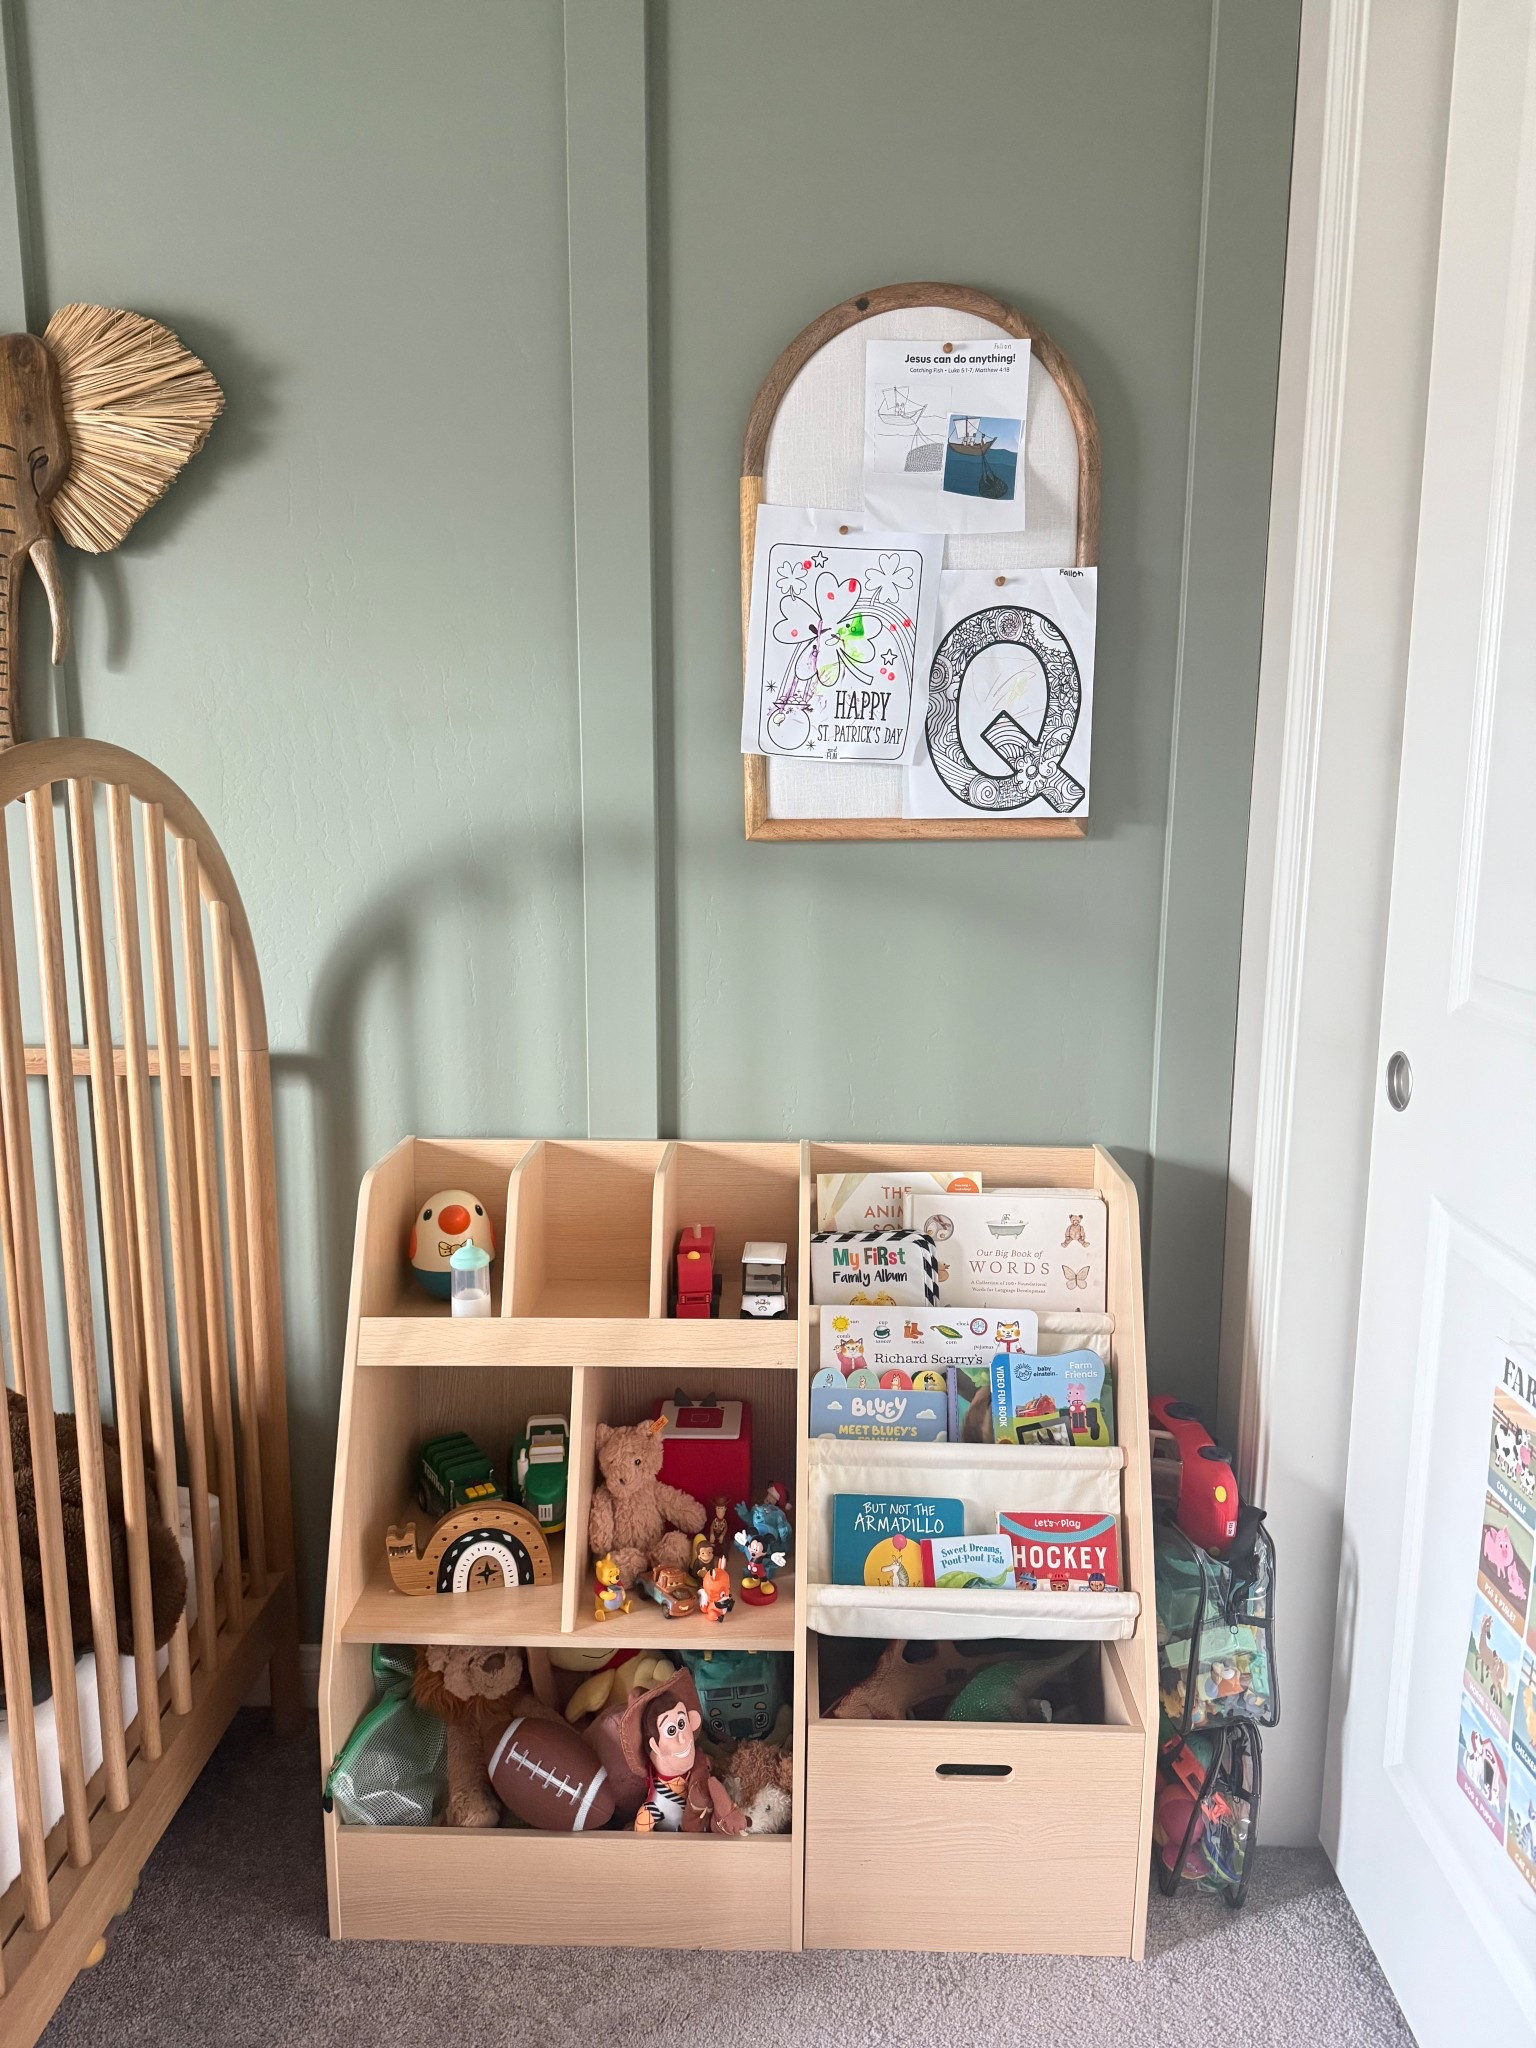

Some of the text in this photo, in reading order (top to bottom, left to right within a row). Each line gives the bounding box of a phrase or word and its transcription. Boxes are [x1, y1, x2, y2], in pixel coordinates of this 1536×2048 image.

[904, 353, 1016, 366] Jesus can do anything!
[909, 366, 933, 375] Catching
[933, 366, 944, 374] Fish
[948, 366, 960, 374] Luke
[975, 365, 998, 374] Matthew
[1059, 568, 1084, 578] Fallon
[833, 690, 892, 721] HAPPY
[925, 605, 1086, 813] Q
[817, 724, 904, 745] ST. PATRICK'S DAY
[832, 1247, 860, 1271] My
[976, 1249, 1044, 1260] Our Big Book of
[969, 1260, 1050, 1275] WORDS
[832, 1268, 908, 1287] Family Album
[875, 1353, 983, 1366] Richard Scarry's
[1069, 1361, 1093, 1370] Farm
[1065, 1370, 1098, 1379] Friends
[996, 1366, 1008, 1427] VIDEO FUN BOOK
[851, 1396, 908, 1424] BLUEY
[838, 1424, 918, 1437] MEET BLUEY'S
[1496, 1480, 1509, 1497] COW
[1513, 1497, 1527, 1515] CALF
[862, 1501, 936, 1516] BUT NOT THE
[854, 1512, 944, 1534] ARMADILLO
[1034, 1518, 1081, 1530] Let's Play
[940, 1543, 1002, 1558] Sweet Dreams,
[1012, 1545, 1108, 1570] HOCKEY
[940, 1553, 1005, 1569] Pout-Pout Fish
[1484, 1582, 1494, 1599] PIG
